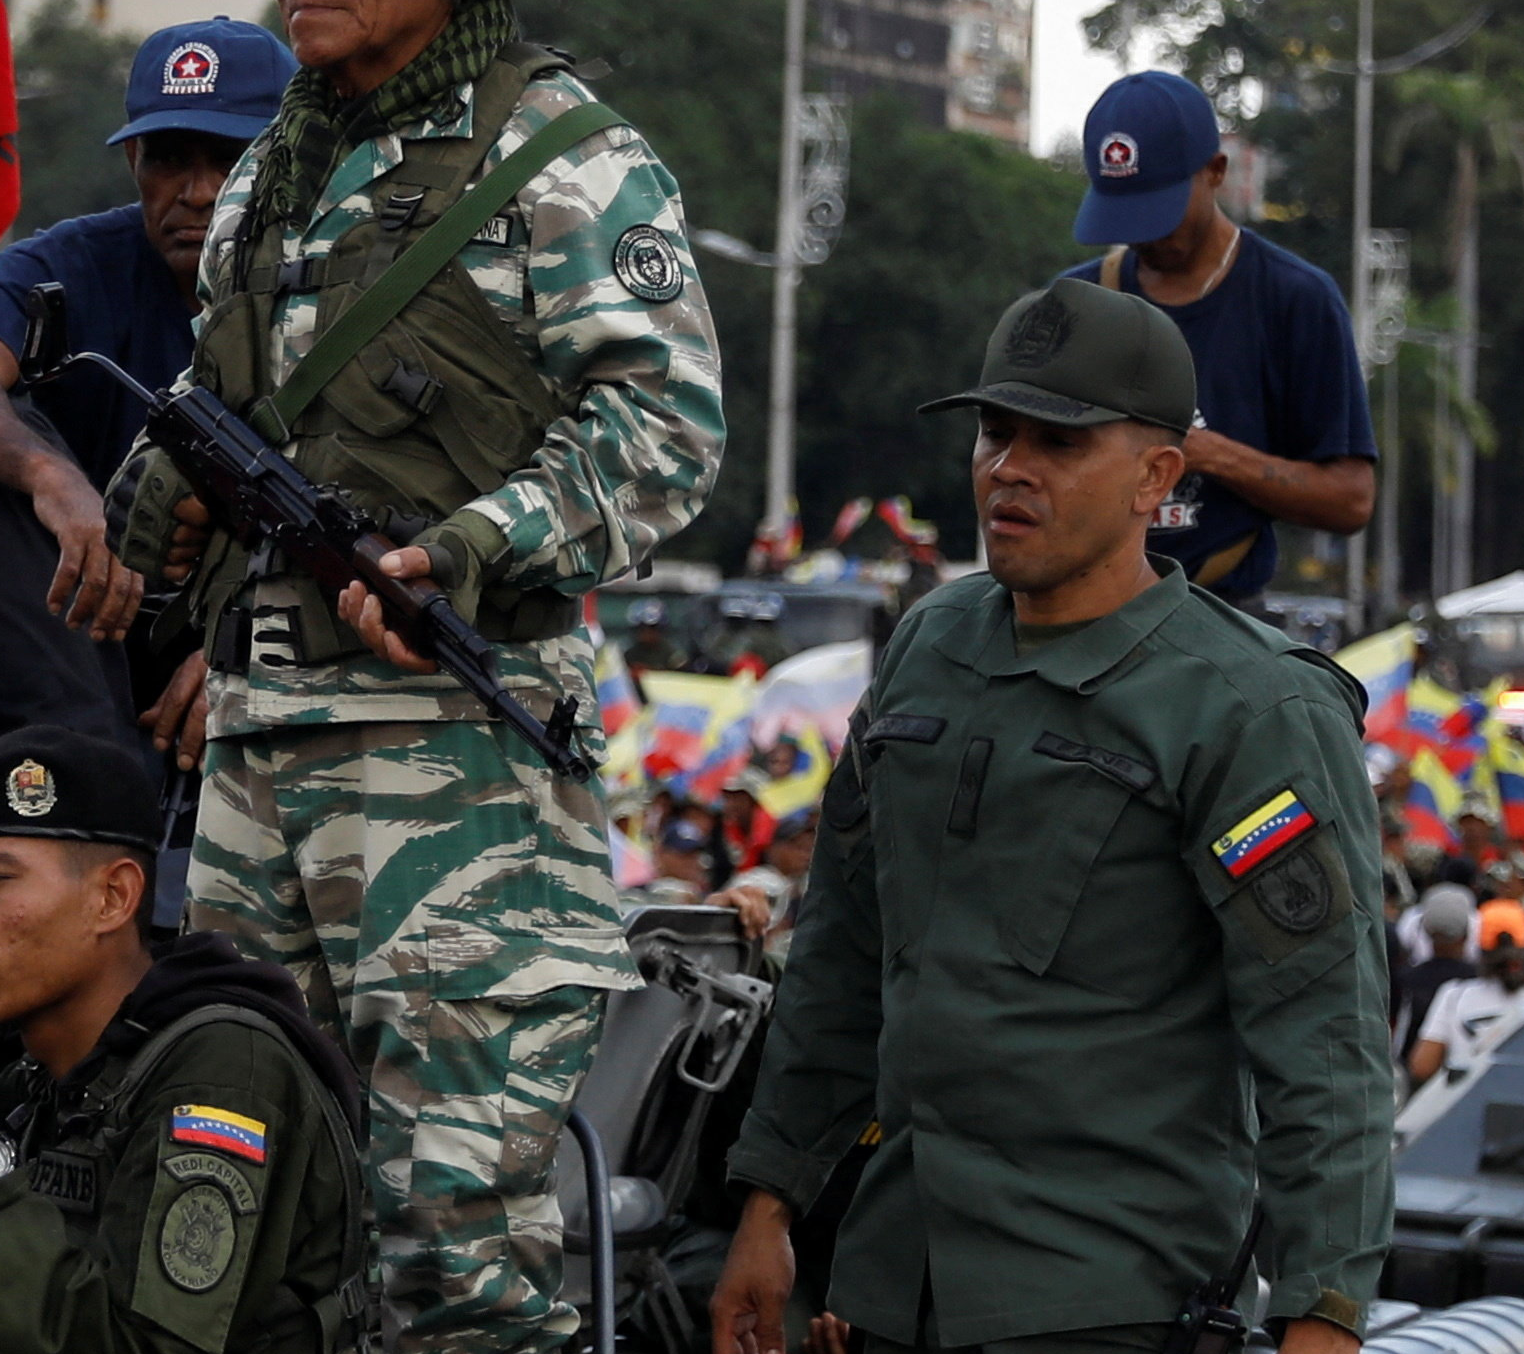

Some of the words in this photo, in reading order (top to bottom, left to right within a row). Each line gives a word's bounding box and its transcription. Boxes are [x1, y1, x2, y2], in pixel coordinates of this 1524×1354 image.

[174, 1158, 203, 1174] REDI
[206, 1160, 250, 1207] CAPITAL
[163, 1243, 219, 1287] BOLIVARIANO
